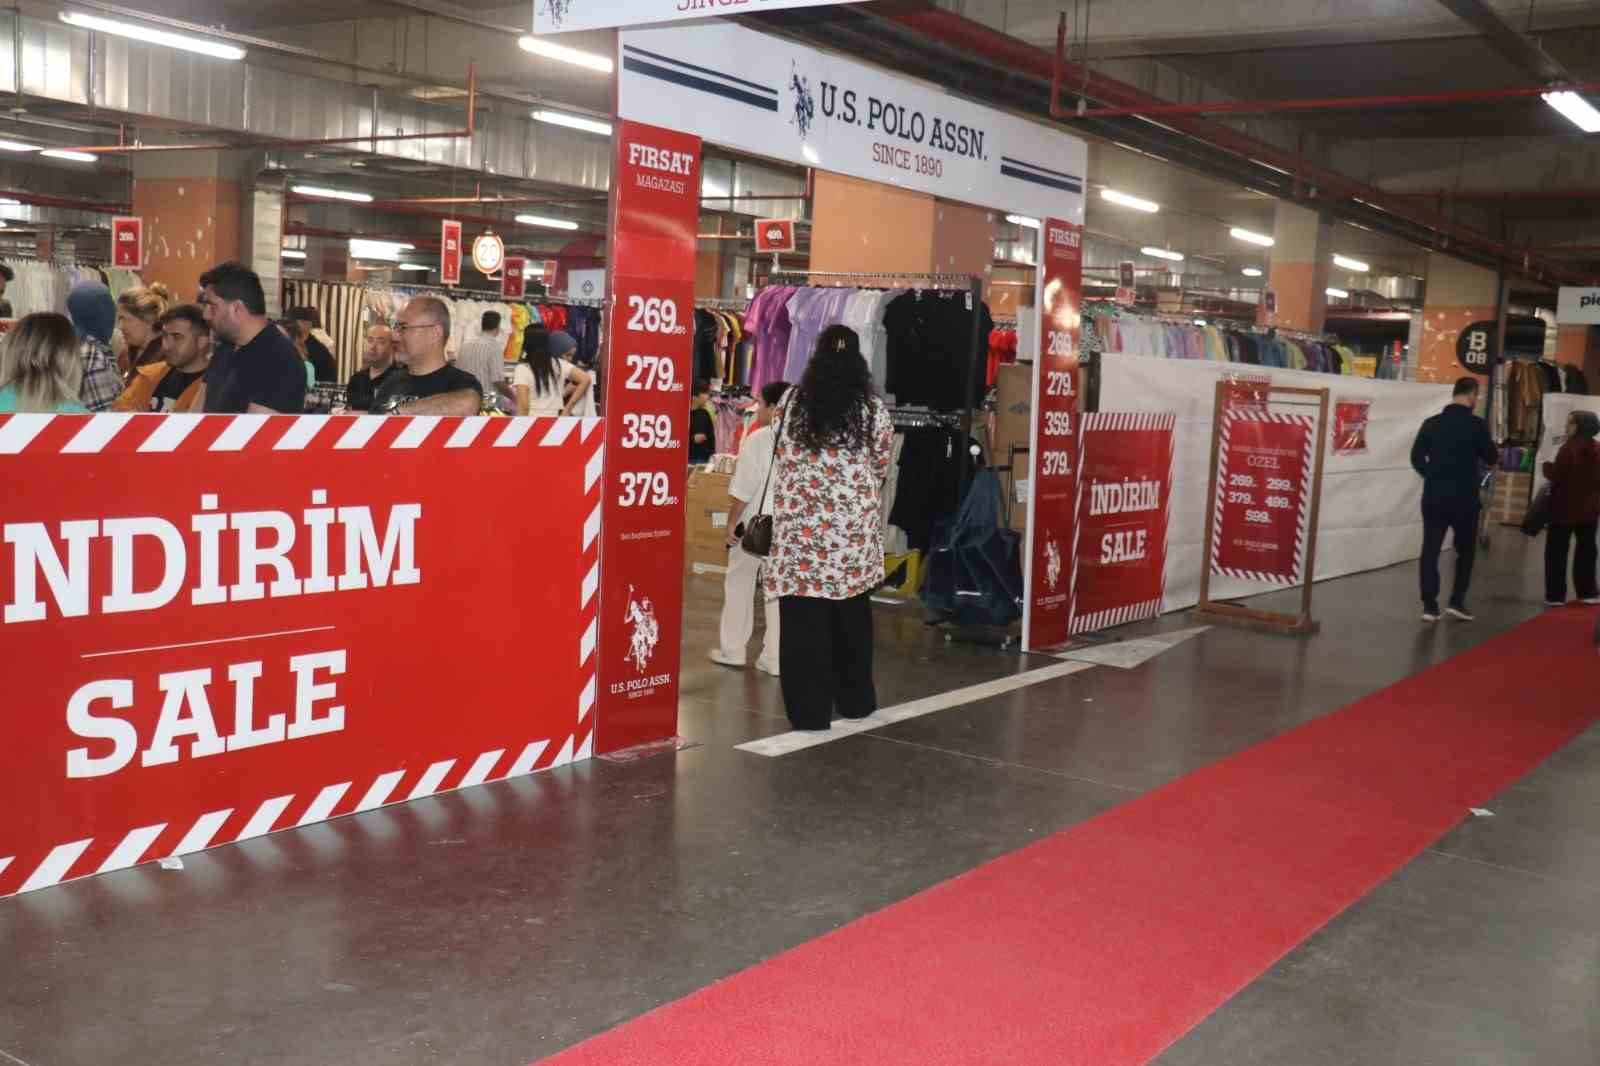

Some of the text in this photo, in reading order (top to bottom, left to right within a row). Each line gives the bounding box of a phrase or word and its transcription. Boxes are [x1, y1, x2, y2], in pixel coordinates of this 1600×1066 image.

[820, 82, 989, 162] U.S. POLO ASSN.
[628, 142, 693, 176] FIRSAT
[872, 142, 943, 178] SINCE 1890
[1467, 331, 1487, 351] B
[1089, 475, 1160, 516] İNDİRİM
[1100, 529, 1147, 565] SALE
[626, 677, 648, 691] POLO
[66, 649, 347, 778] SALE
